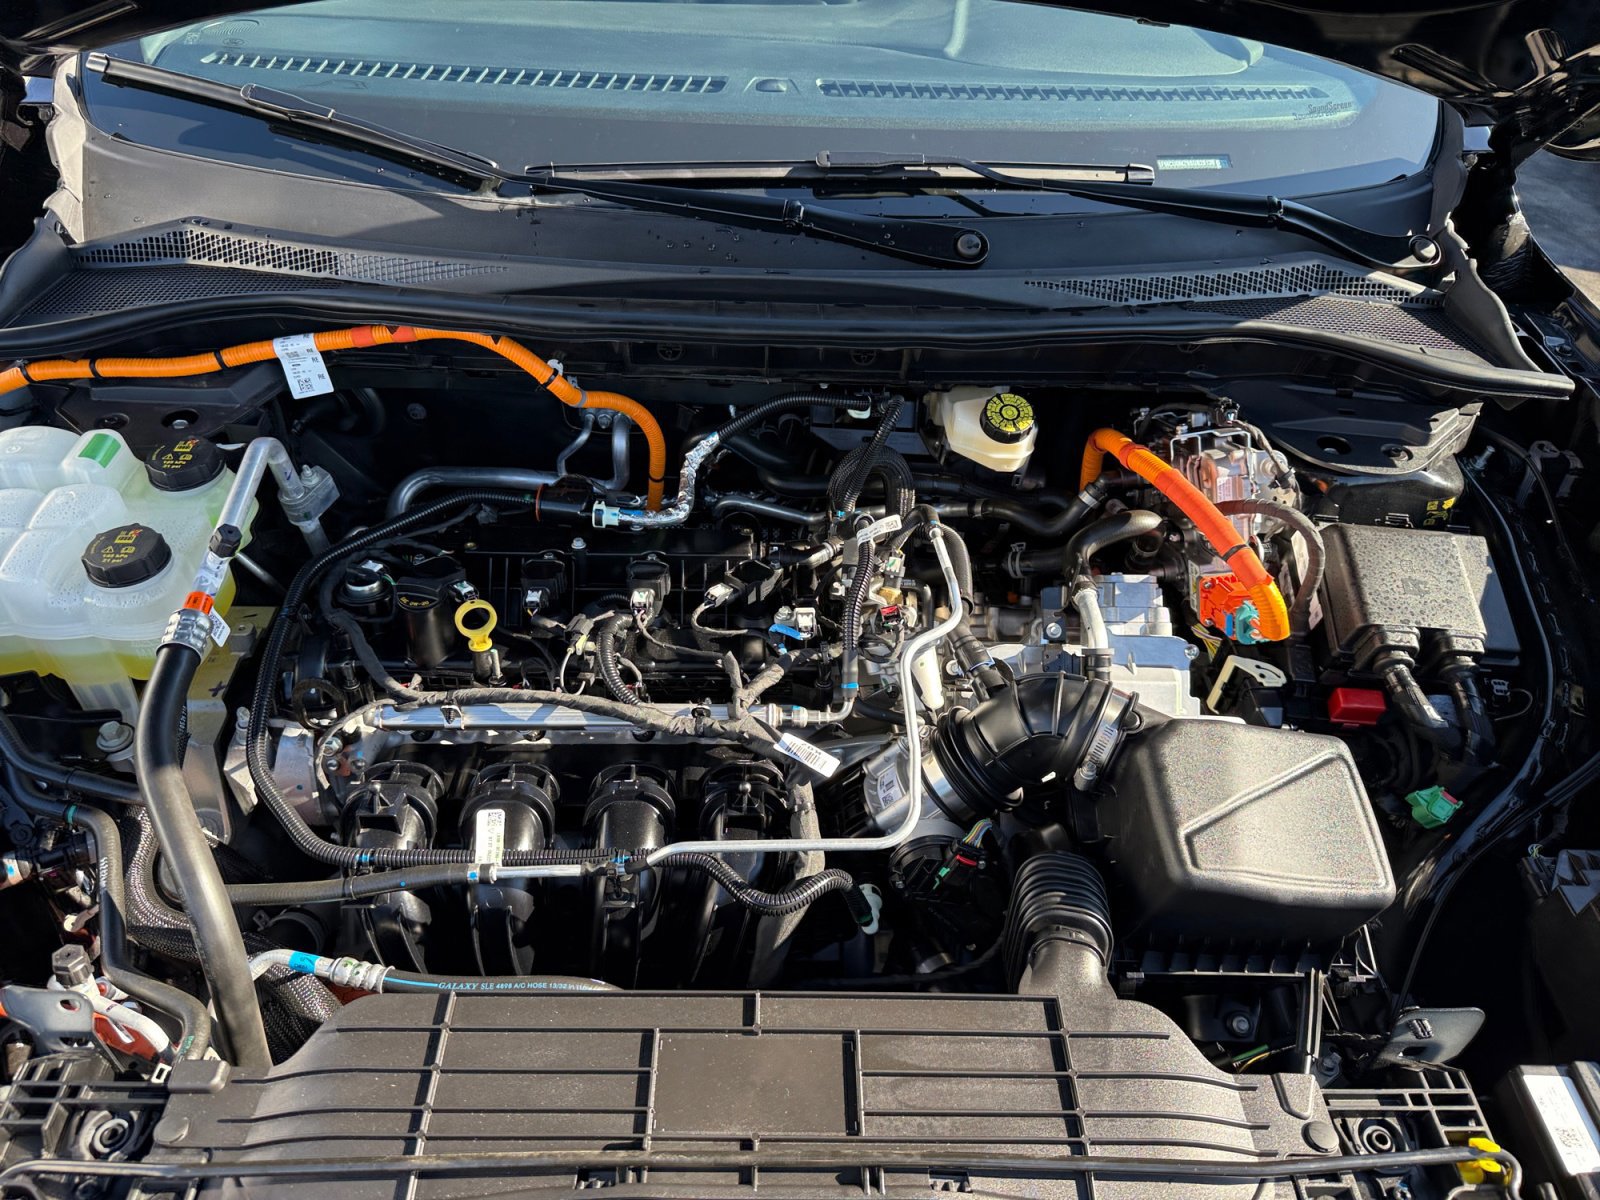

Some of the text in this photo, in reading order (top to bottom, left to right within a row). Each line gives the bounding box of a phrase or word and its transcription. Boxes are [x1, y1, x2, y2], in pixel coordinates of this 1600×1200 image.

[1308, 101, 1352, 113] SoundScreen
[438, 982, 478, 990] GALAXY
[481, 982, 494, 990] SLE
